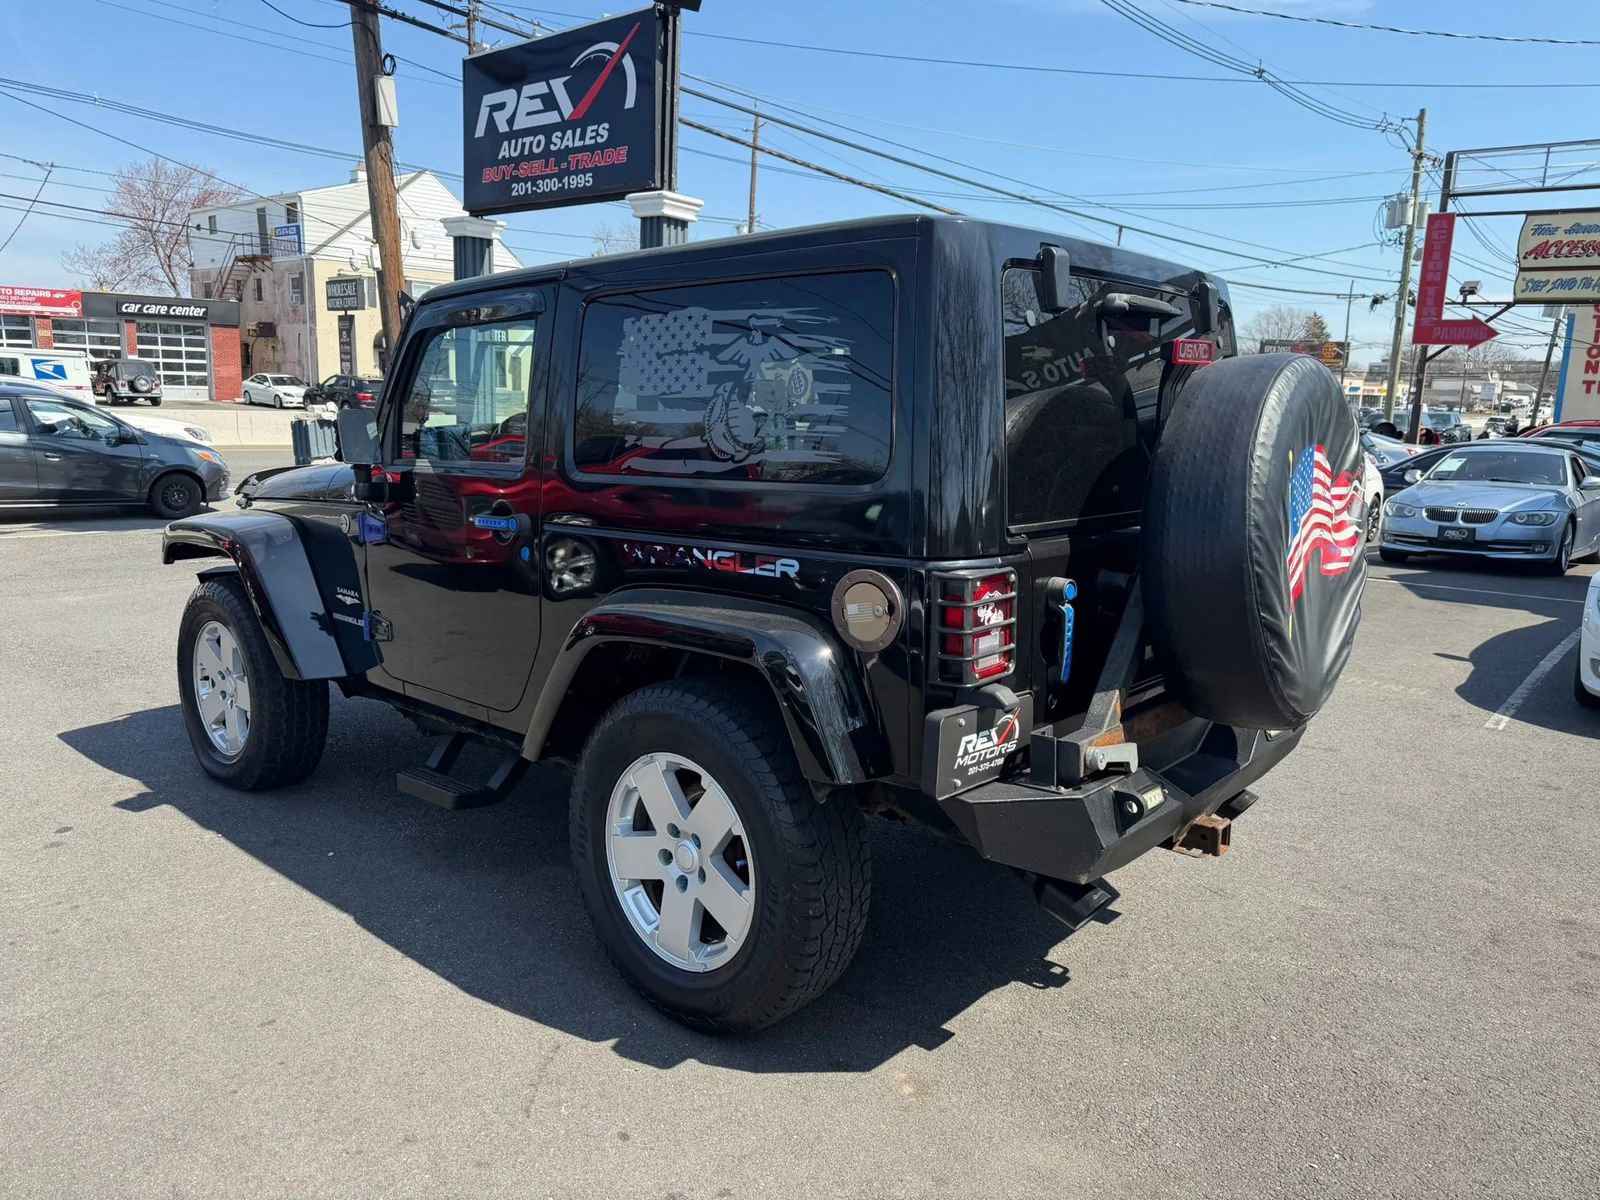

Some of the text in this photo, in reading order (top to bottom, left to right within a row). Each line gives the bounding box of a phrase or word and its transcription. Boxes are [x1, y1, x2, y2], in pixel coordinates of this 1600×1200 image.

[498, 122, 610, 160] AUTO SALES
[511, 173, 593, 197] 201-300-1995
[1426, 219, 1449, 282] ACTION
[0, 287, 52, 298] TO REPAIRS
[121, 303, 206, 317] car care center
[1432, 326, 1489, 340] PARKING
[1179, 342, 1210, 359] USMC
[333, 612, 365, 627] WRANGLE
[954, 740, 1018, 769] MOTORS
